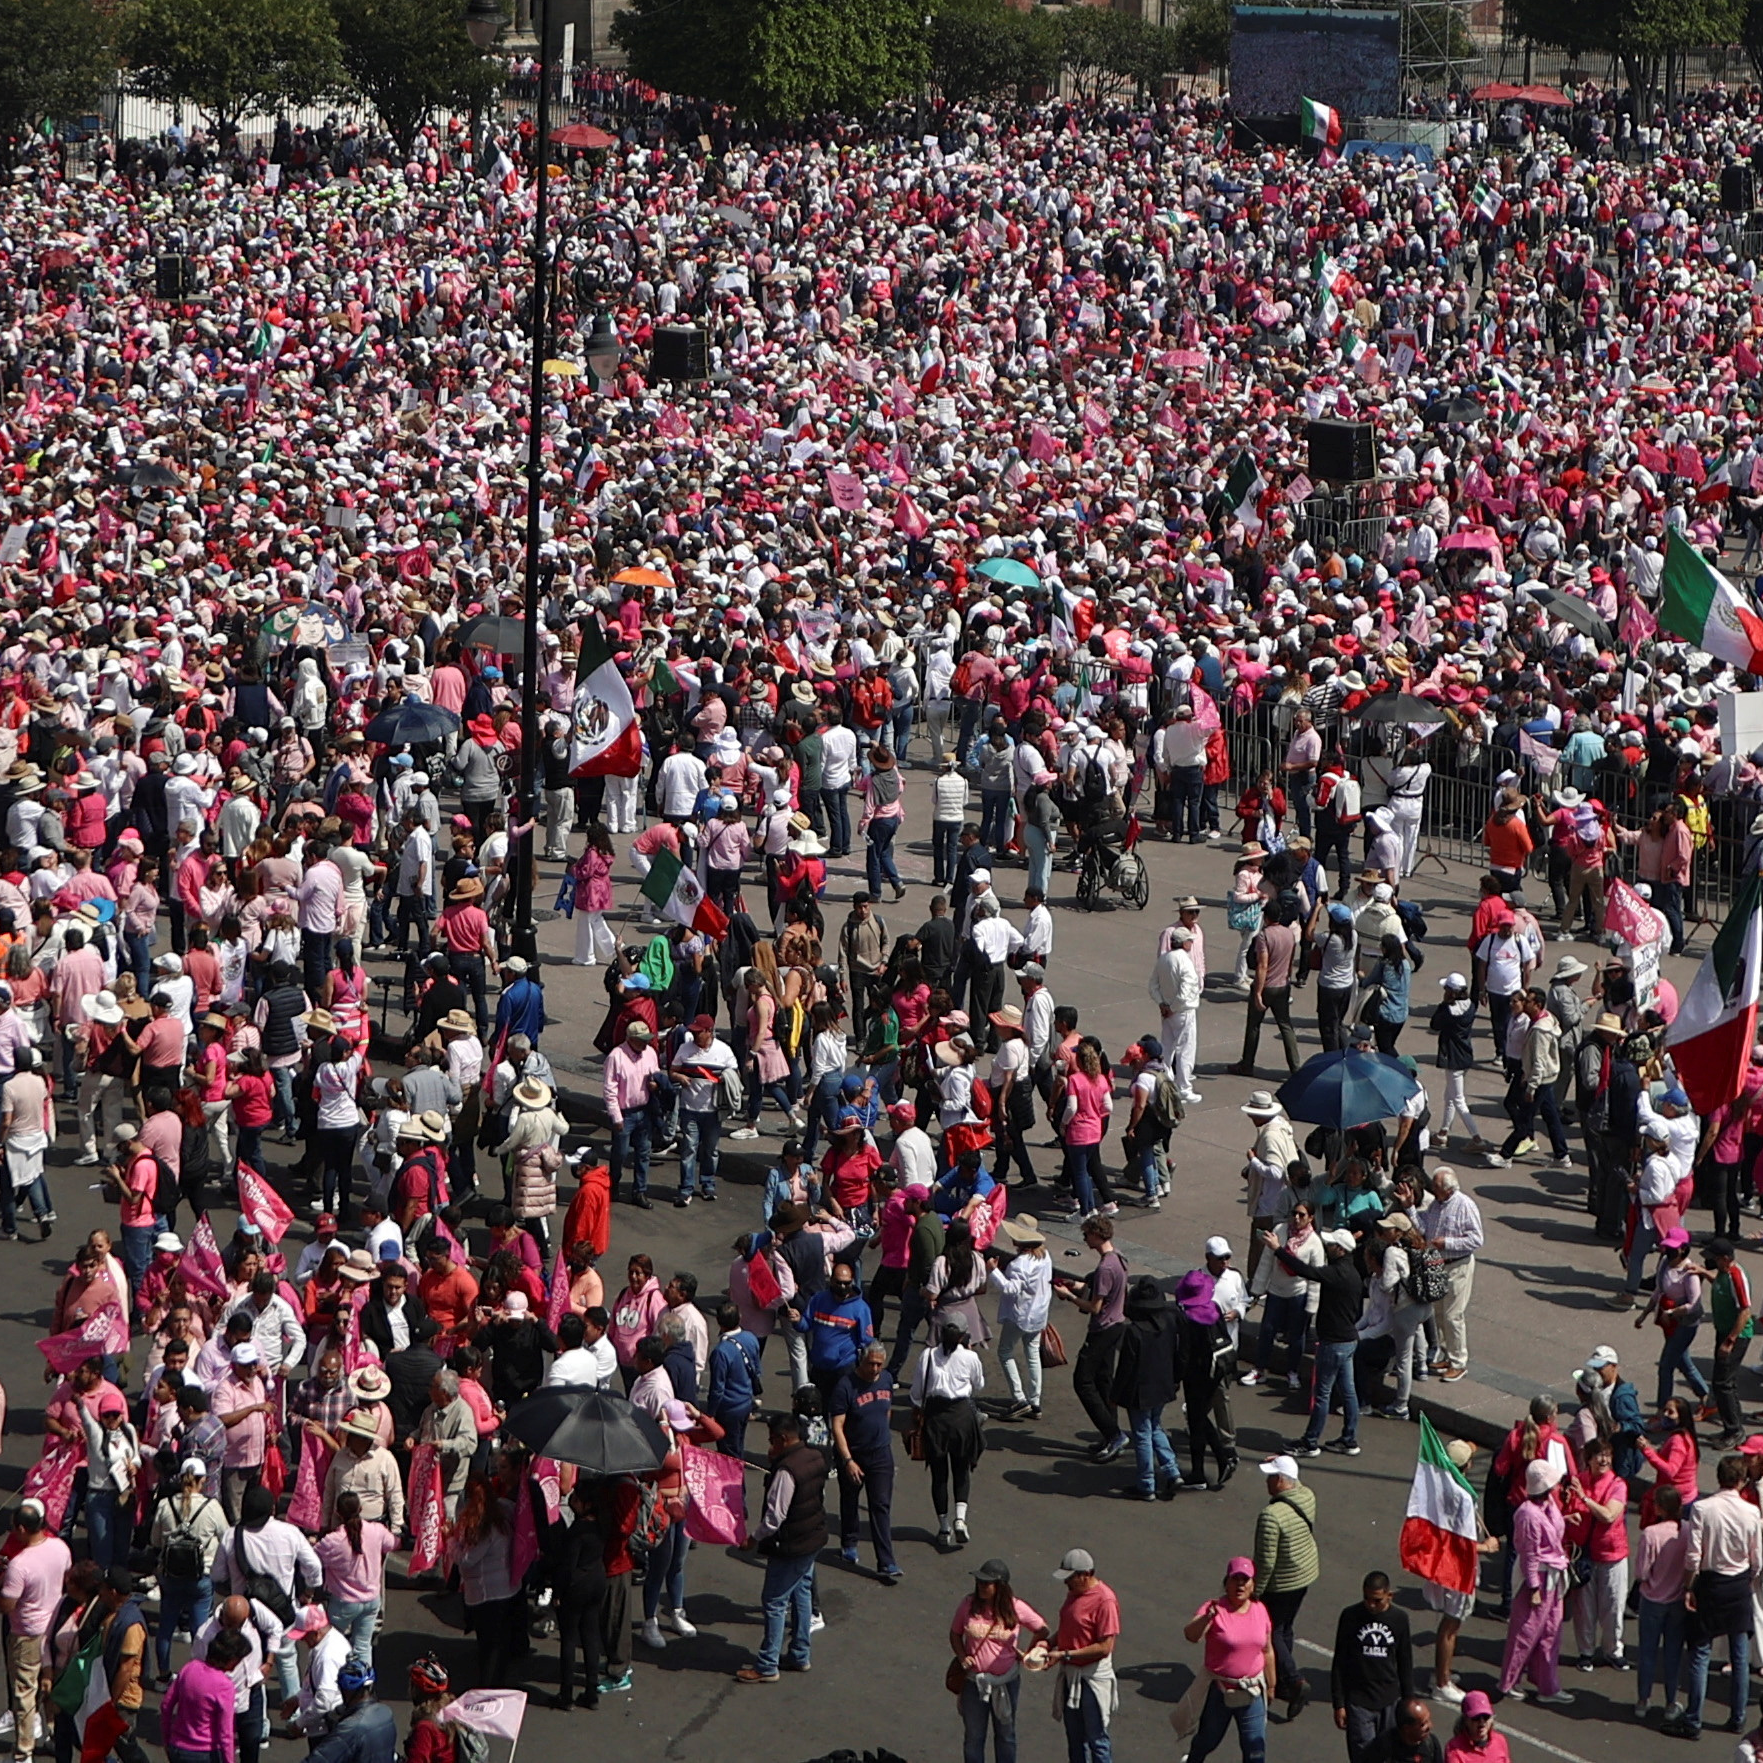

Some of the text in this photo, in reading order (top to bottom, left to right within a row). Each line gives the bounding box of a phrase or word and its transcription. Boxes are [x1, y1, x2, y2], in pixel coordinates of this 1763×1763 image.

[857, 1392, 874, 1406] RED
[1357, 1622, 1395, 1644] AMERICAN
[1363, 1646, 1387, 1656] EAGLE
